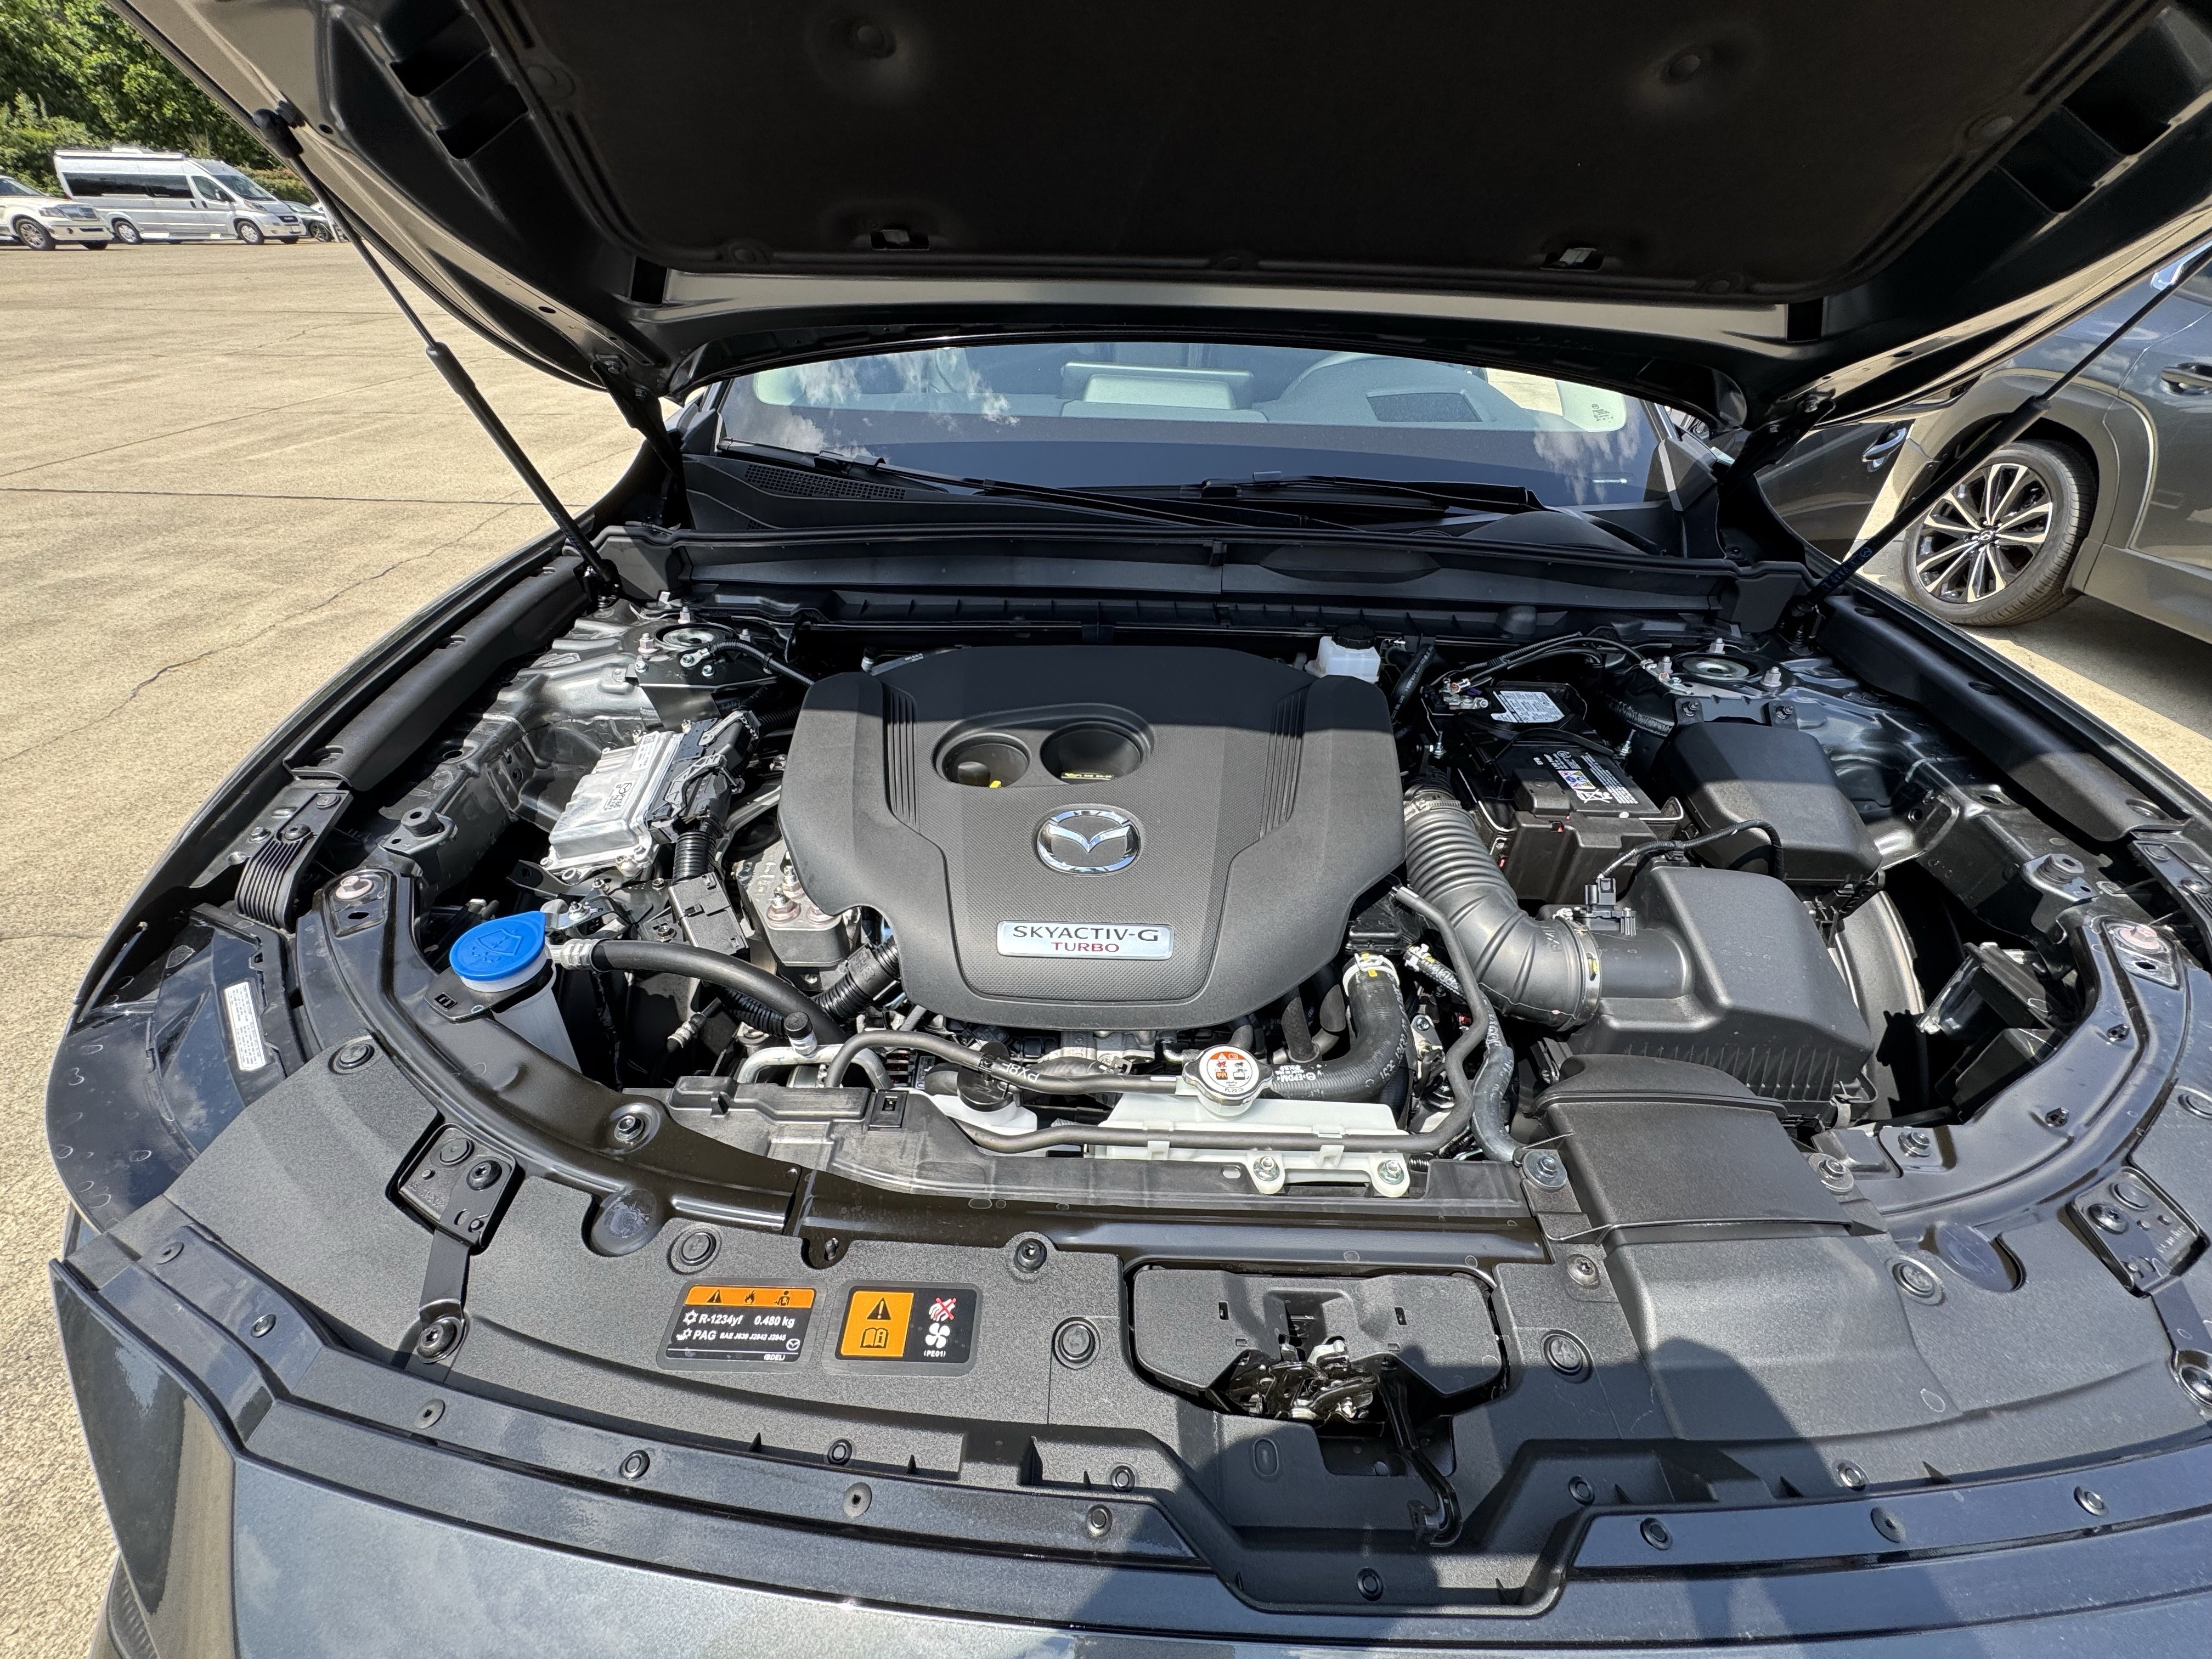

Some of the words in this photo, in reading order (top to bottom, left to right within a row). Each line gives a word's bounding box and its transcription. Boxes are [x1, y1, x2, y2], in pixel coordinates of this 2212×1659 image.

[1013, 925, 1159, 941] SKYACTIV-G
[1051, 942, 1119, 952] TURBO
[998, 1063, 1040, 1084] PX8F
[698, 1314, 744, 1327] R-1234yf
[754, 1316, 781, 1325] 0.480
[782, 1316, 795, 1328] kg
[692, 1330, 717, 1340] PAG
